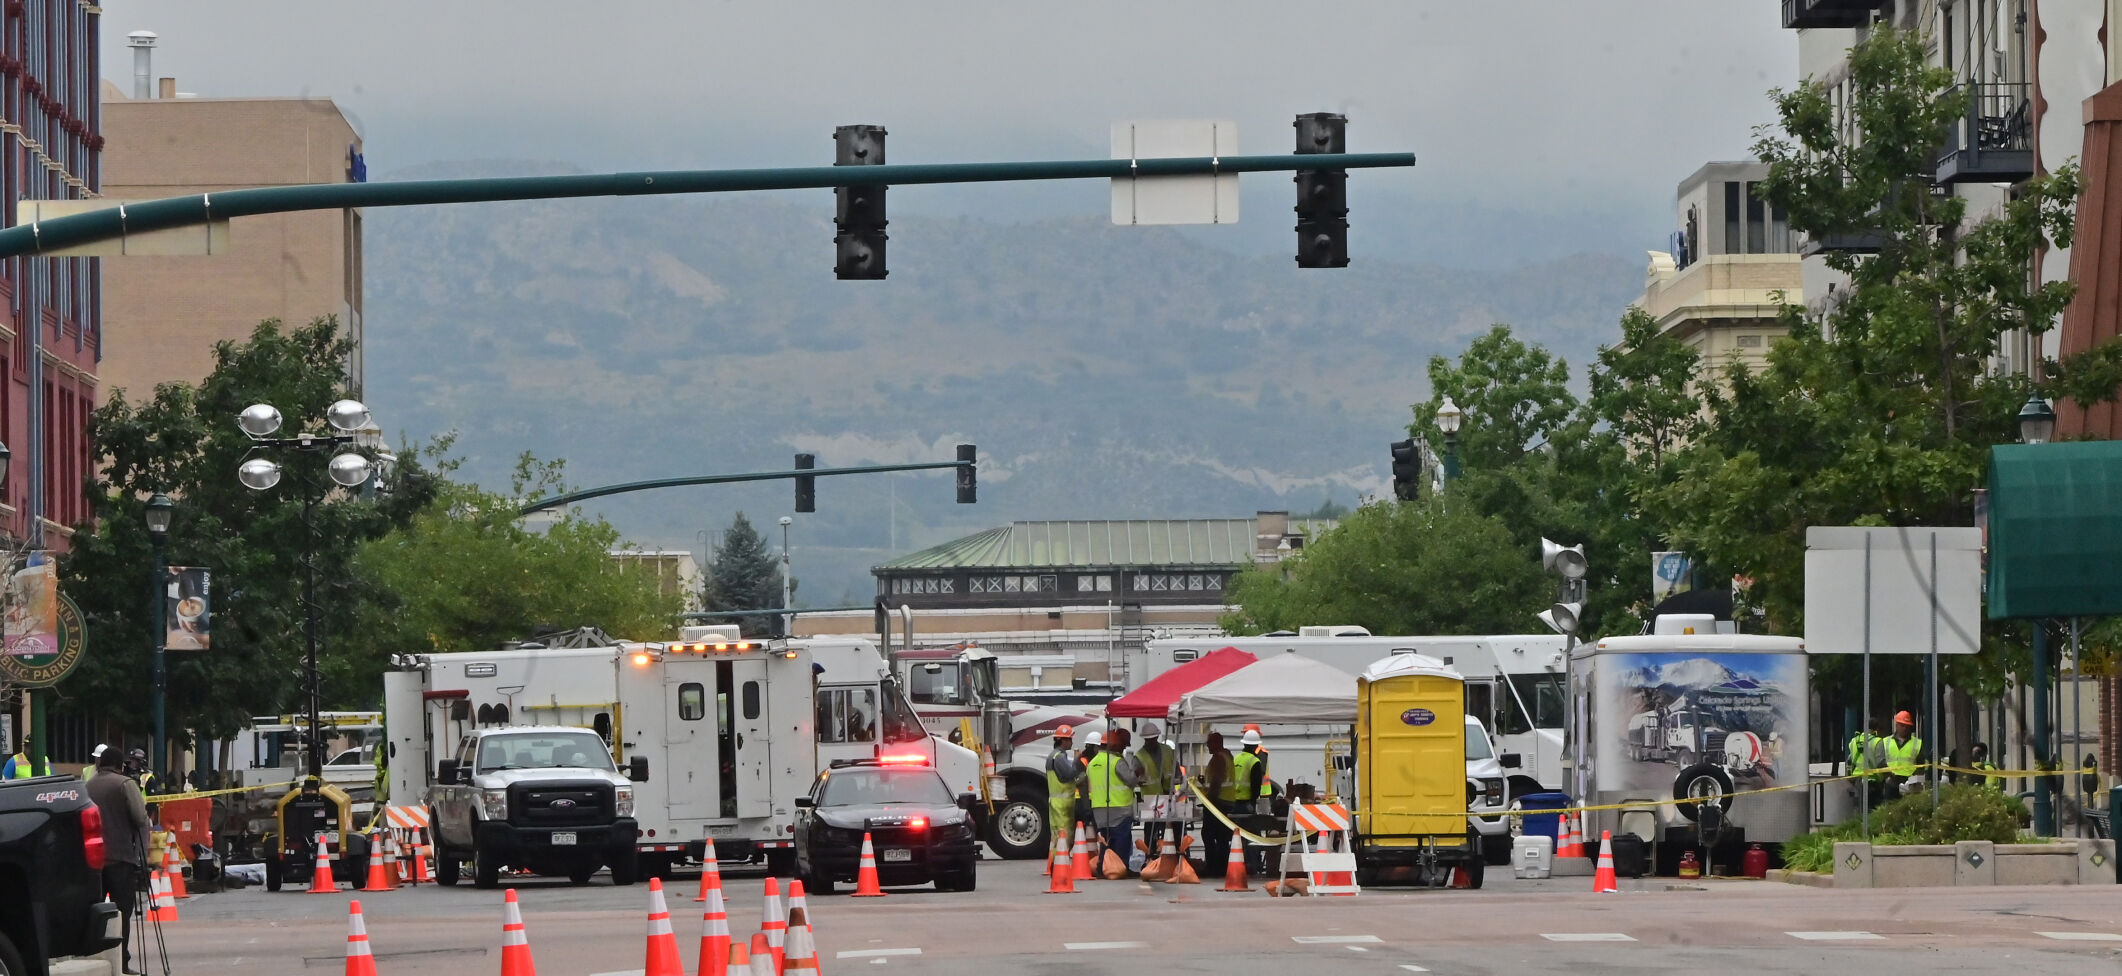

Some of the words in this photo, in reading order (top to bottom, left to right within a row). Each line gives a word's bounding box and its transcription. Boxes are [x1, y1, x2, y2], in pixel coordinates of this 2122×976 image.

[202, 571, 210, 596] enjoy
[0, 655, 28, 679] BLIC
[33, 639, 79, 680] PARKING
